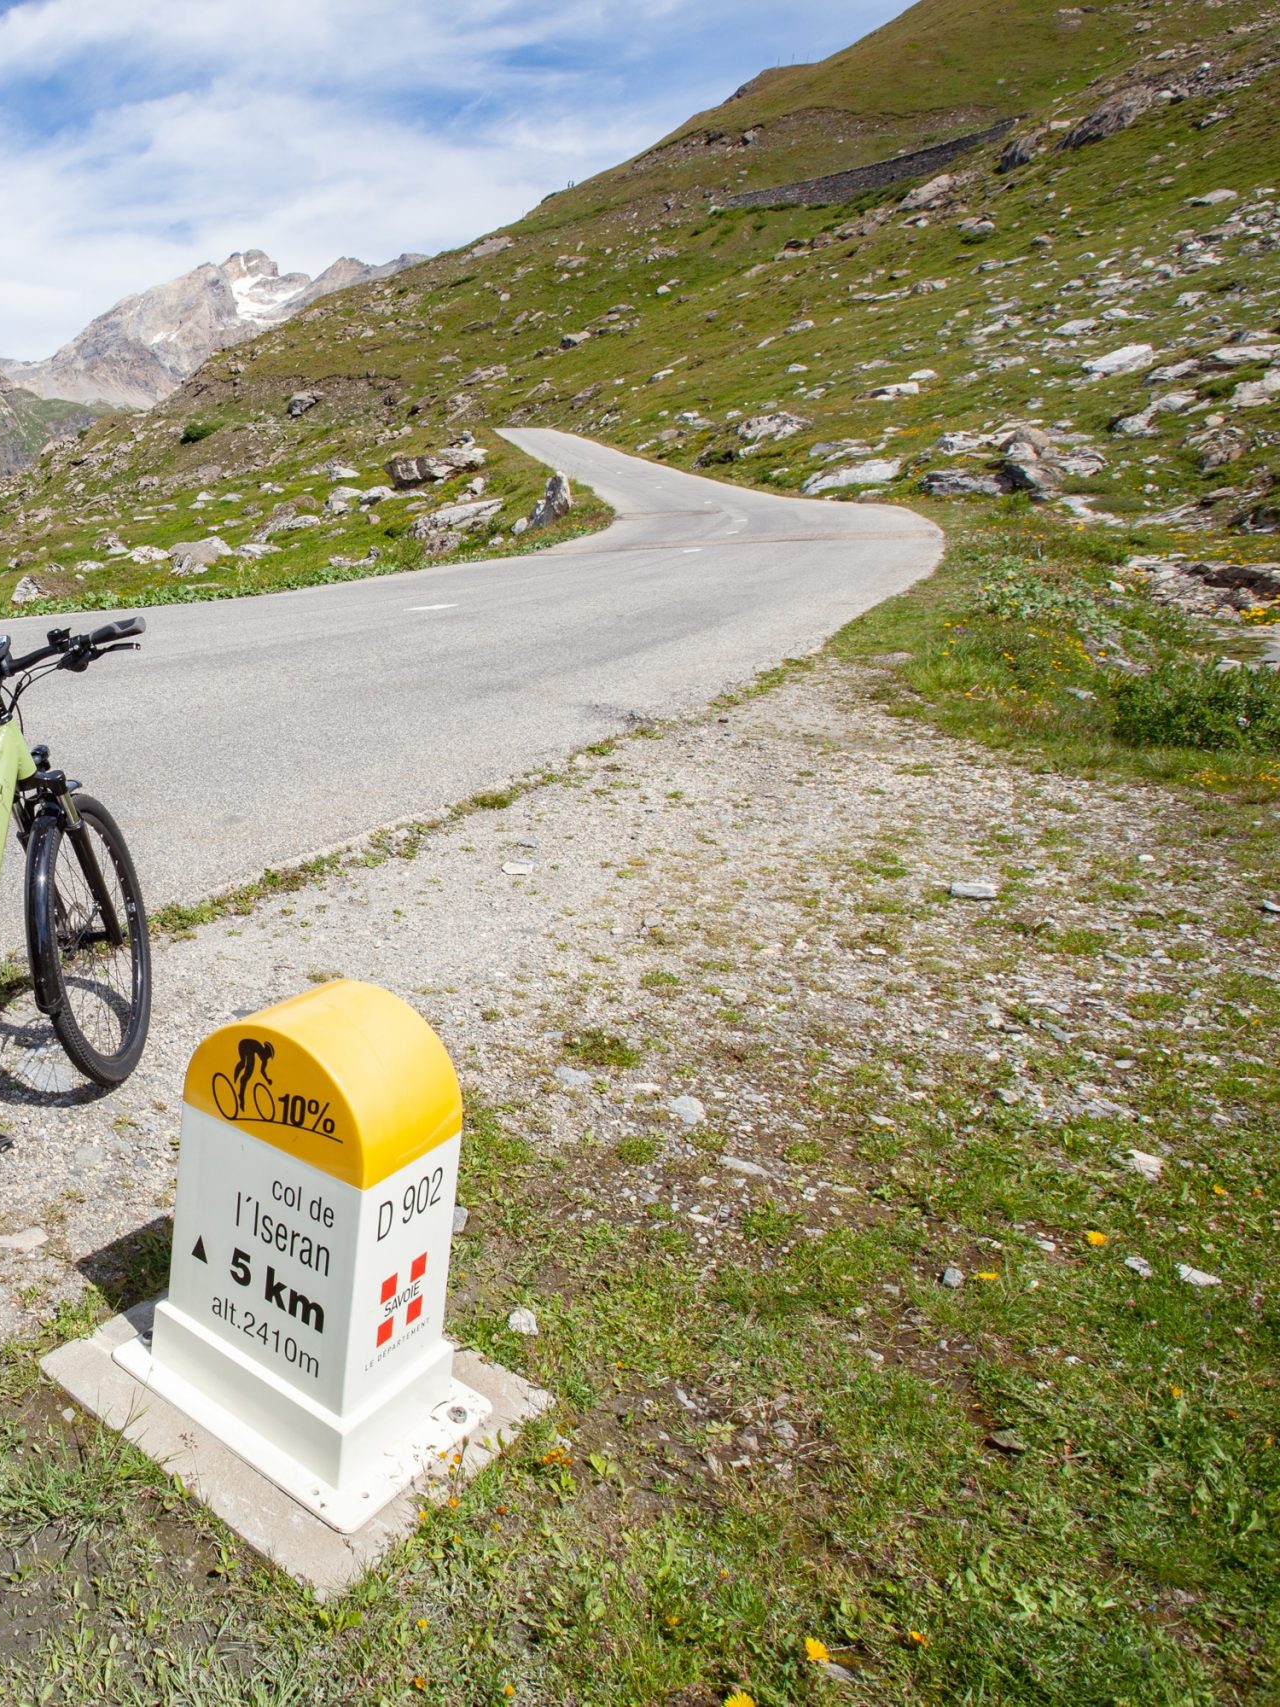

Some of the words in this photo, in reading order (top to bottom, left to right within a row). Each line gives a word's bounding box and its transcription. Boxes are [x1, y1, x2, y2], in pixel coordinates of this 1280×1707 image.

[278, 1093, 336, 1135] 10%
[271, 1179, 302, 1213] col
[309, 1197, 335, 1229] de
[376, 1200, 394, 1243] D
[401, 1166, 445, 1226] 902
[229, 1247, 252, 1288] 5
[265, 1265, 326, 1334] km
[384, 1280, 421, 1318] SAVOIE
[364, 1359, 375, 1373] LE
